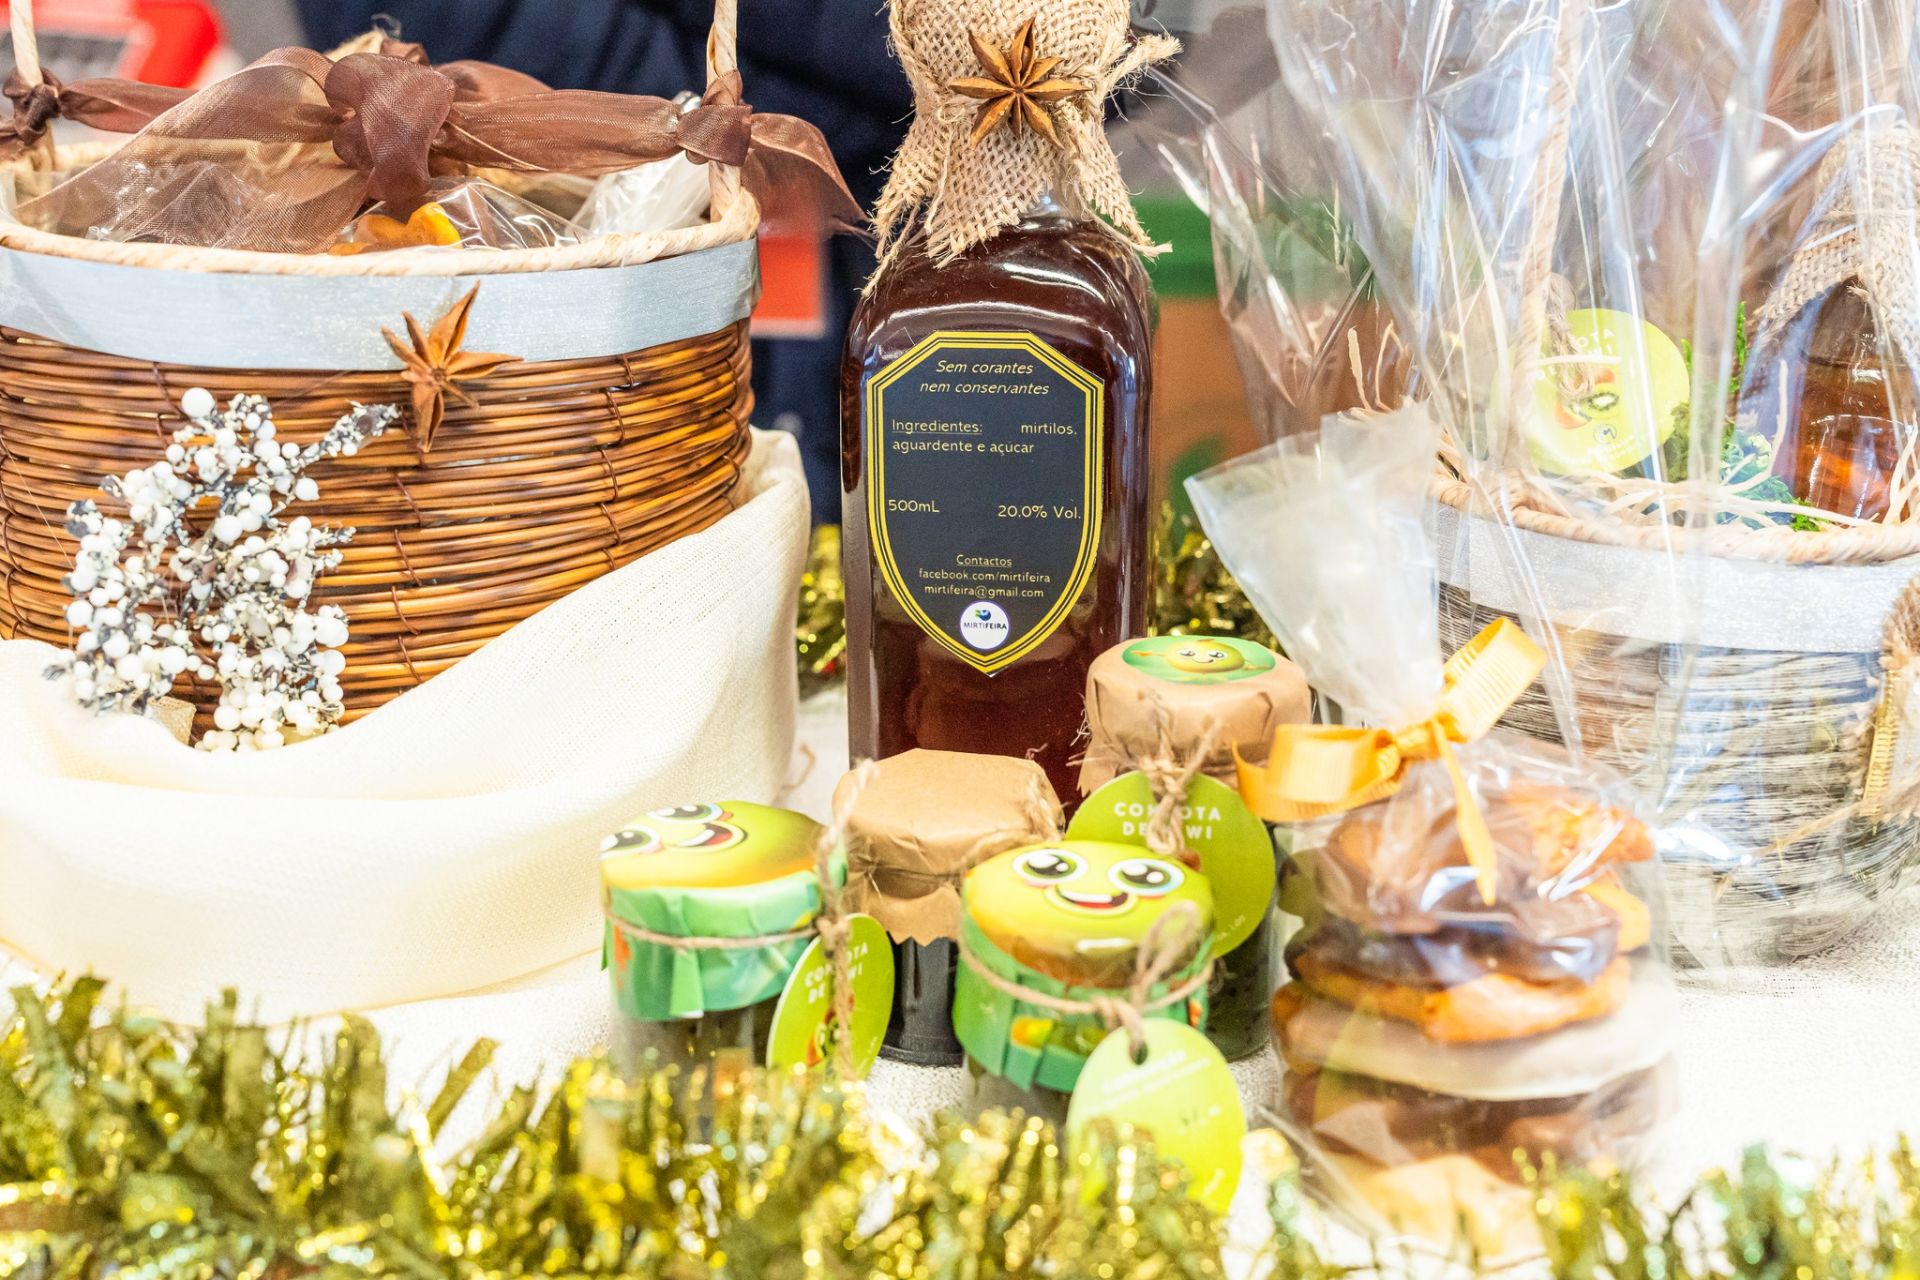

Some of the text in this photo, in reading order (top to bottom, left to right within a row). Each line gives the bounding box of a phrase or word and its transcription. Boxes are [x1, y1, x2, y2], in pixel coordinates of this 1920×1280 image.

[936, 359, 1034, 375] Sem corantes
[919, 382, 1050, 395] nem conservantes
[892, 419, 983, 435] Ingredientes:
[892, 439, 1035, 457] aguardente e açúcar
[888, 499, 1082, 519] 500mL 20.0% Vol.
[956, 554, 1013, 568] Contactos
[918, 567, 1051, 584] facebook.com/mirtifeira
[924, 584, 1045, 599] mirtifeira@gmail.com
[963, 621, 1008, 631] MIRTIFEIRA
